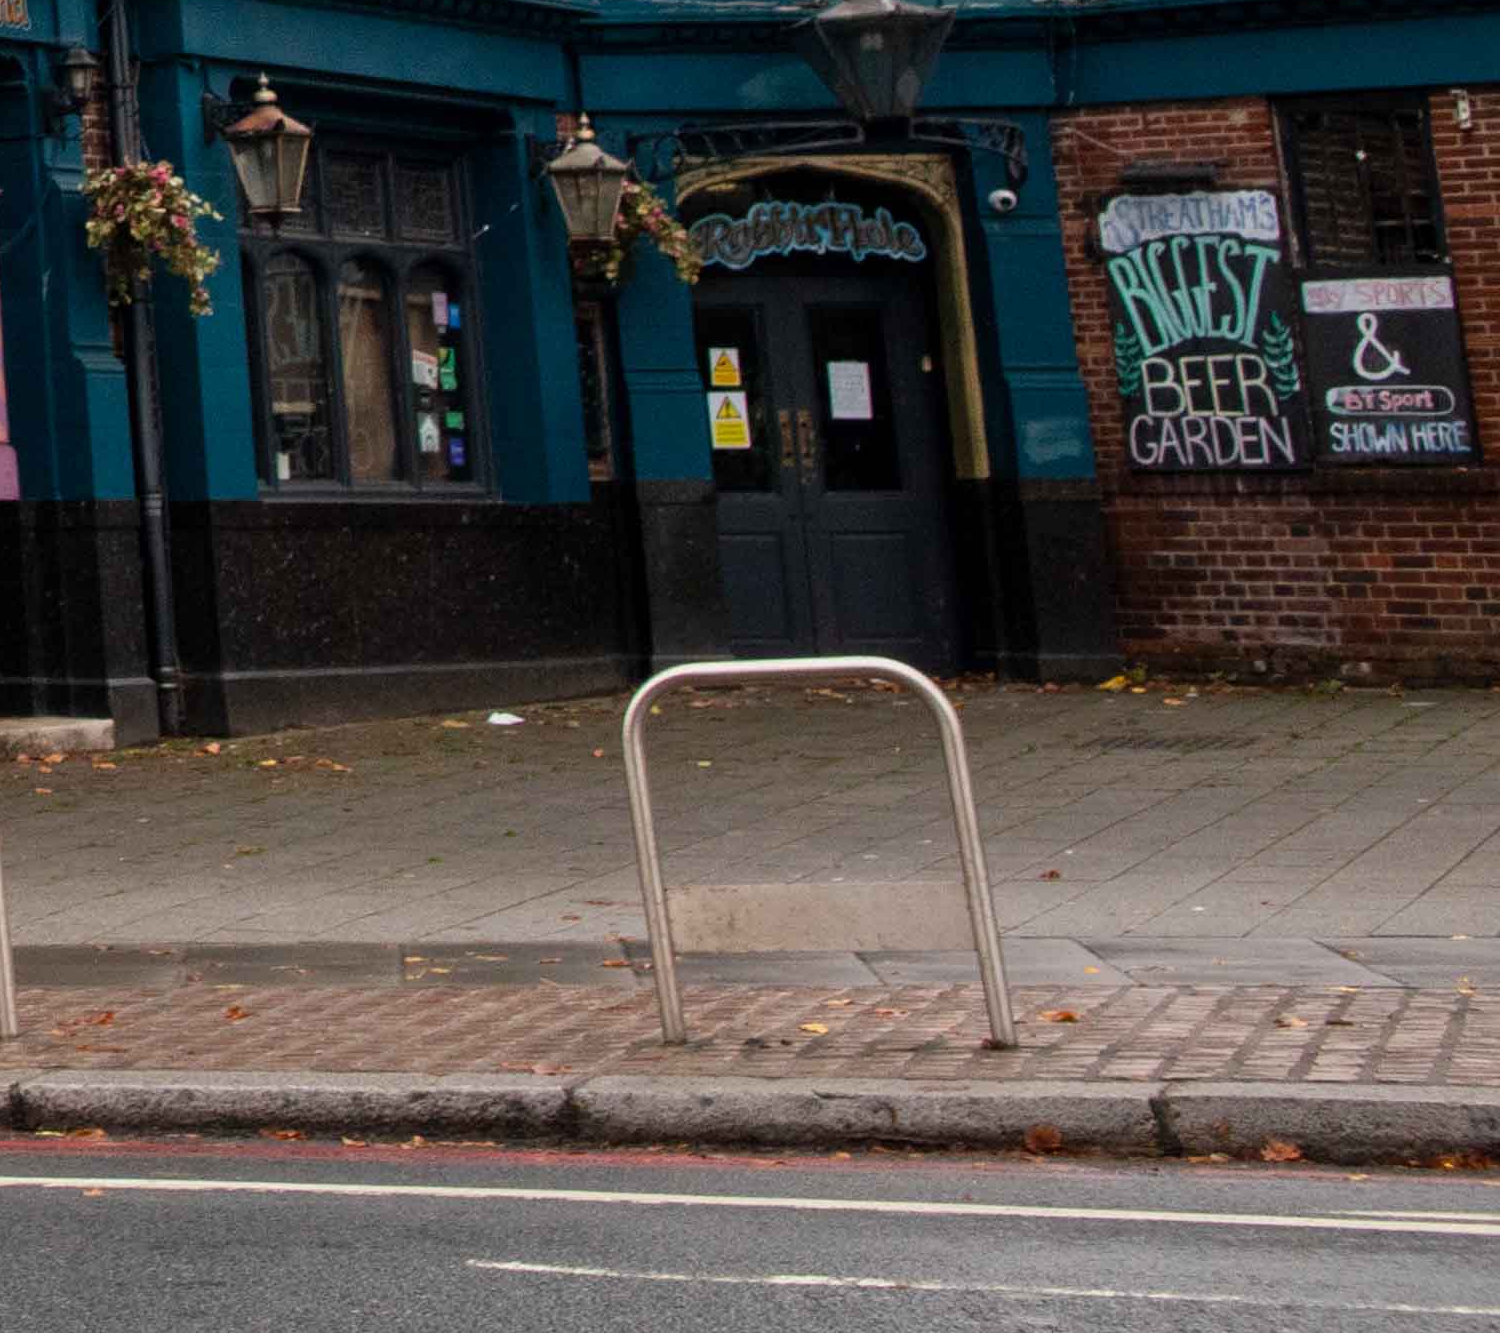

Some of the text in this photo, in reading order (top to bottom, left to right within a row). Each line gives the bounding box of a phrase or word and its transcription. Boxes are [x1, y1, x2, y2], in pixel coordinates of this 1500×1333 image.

[1108, 235, 1281, 356] BIGGEST
[1353, 312, 1412, 381] &
[1142, 354, 1278, 417] BEER
[1378, 389, 1435, 412] Sport
[1129, 415, 1295, 465] GARDEN
[1329, 420, 1472, 452] SHOWN HERE
